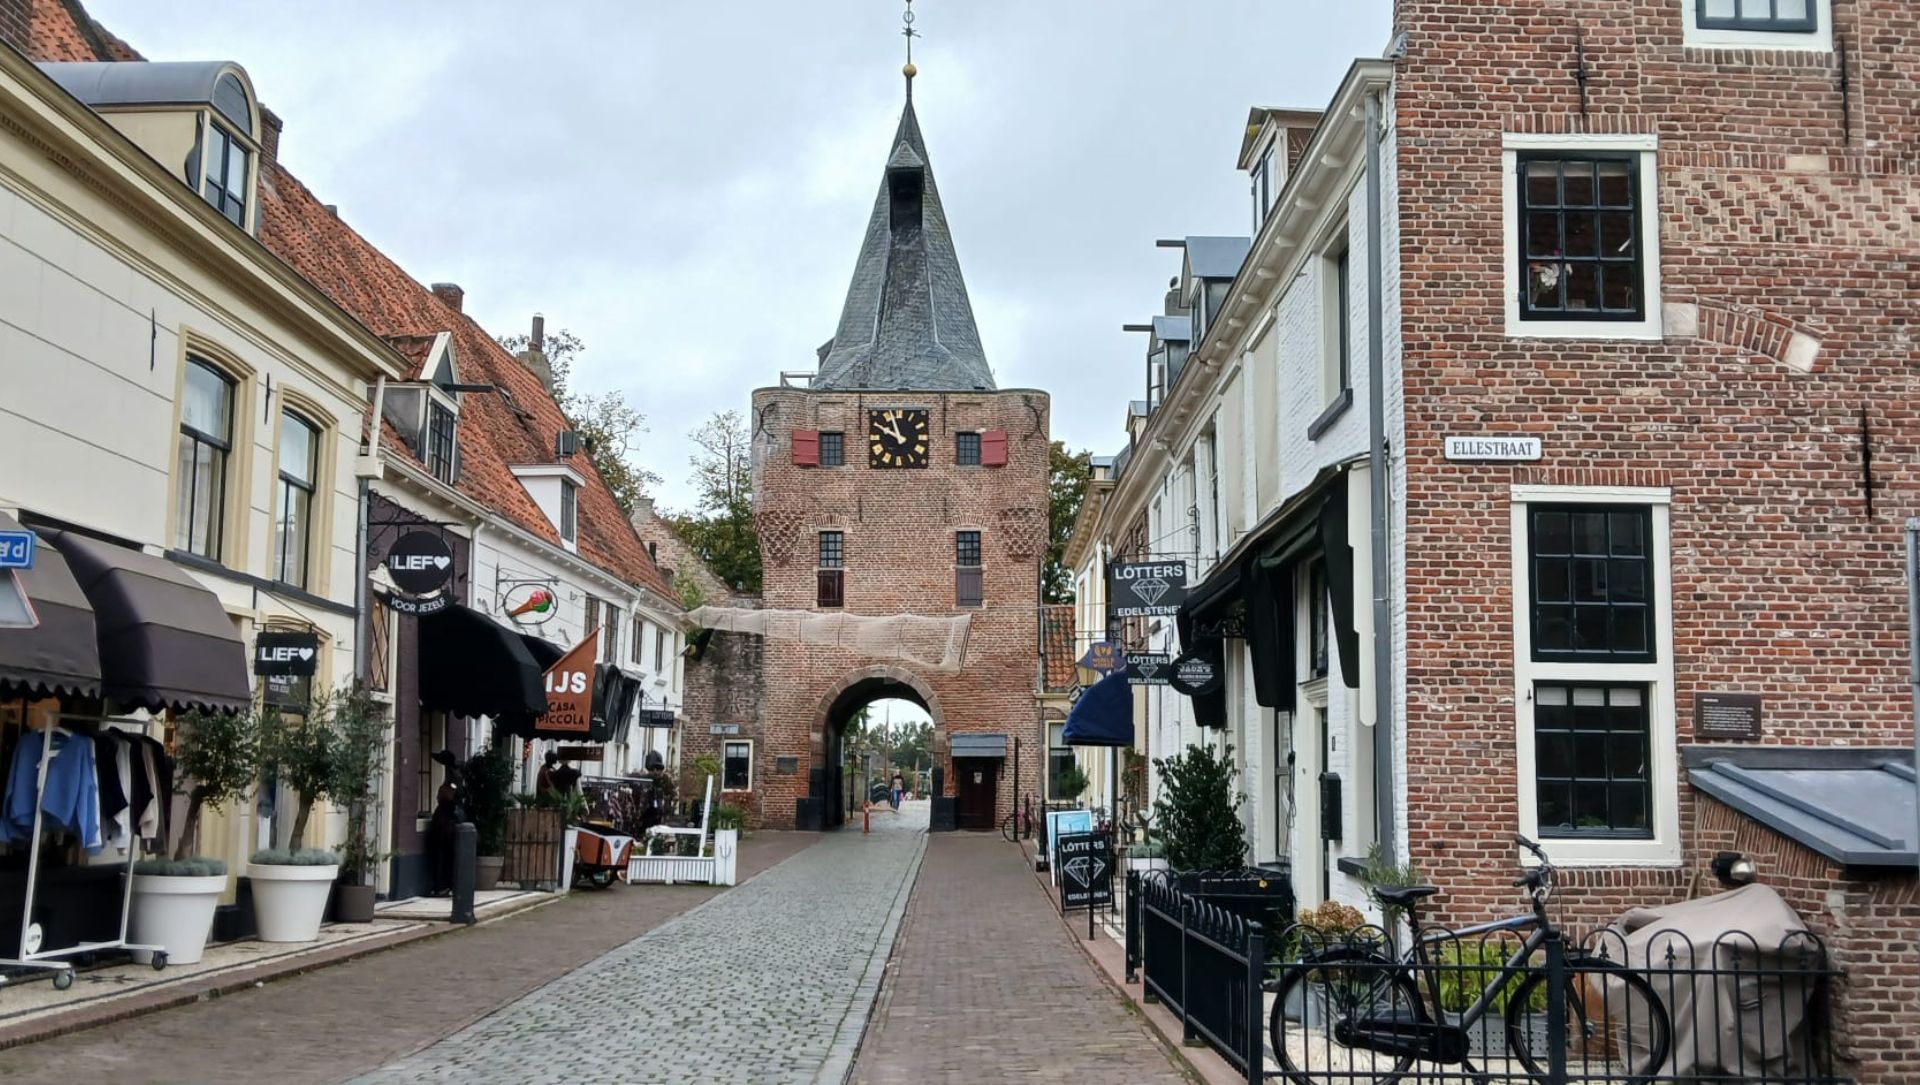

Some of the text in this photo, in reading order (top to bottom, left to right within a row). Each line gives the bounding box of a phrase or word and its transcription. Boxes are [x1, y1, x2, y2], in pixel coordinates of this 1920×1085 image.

[1453, 441, 1533, 456] ELLESTRAAT
[1115, 565, 1184, 580] LÖTTERS
[391, 597, 445, 613] VOOR JEZELF
[1117, 605, 1181, 617] EDELSTENE
[261, 646, 299, 661] LIEF
[545, 671, 586, 694] IJS
[548, 702, 576, 712] CASA
[538, 713, 585, 726] PICCOLA
